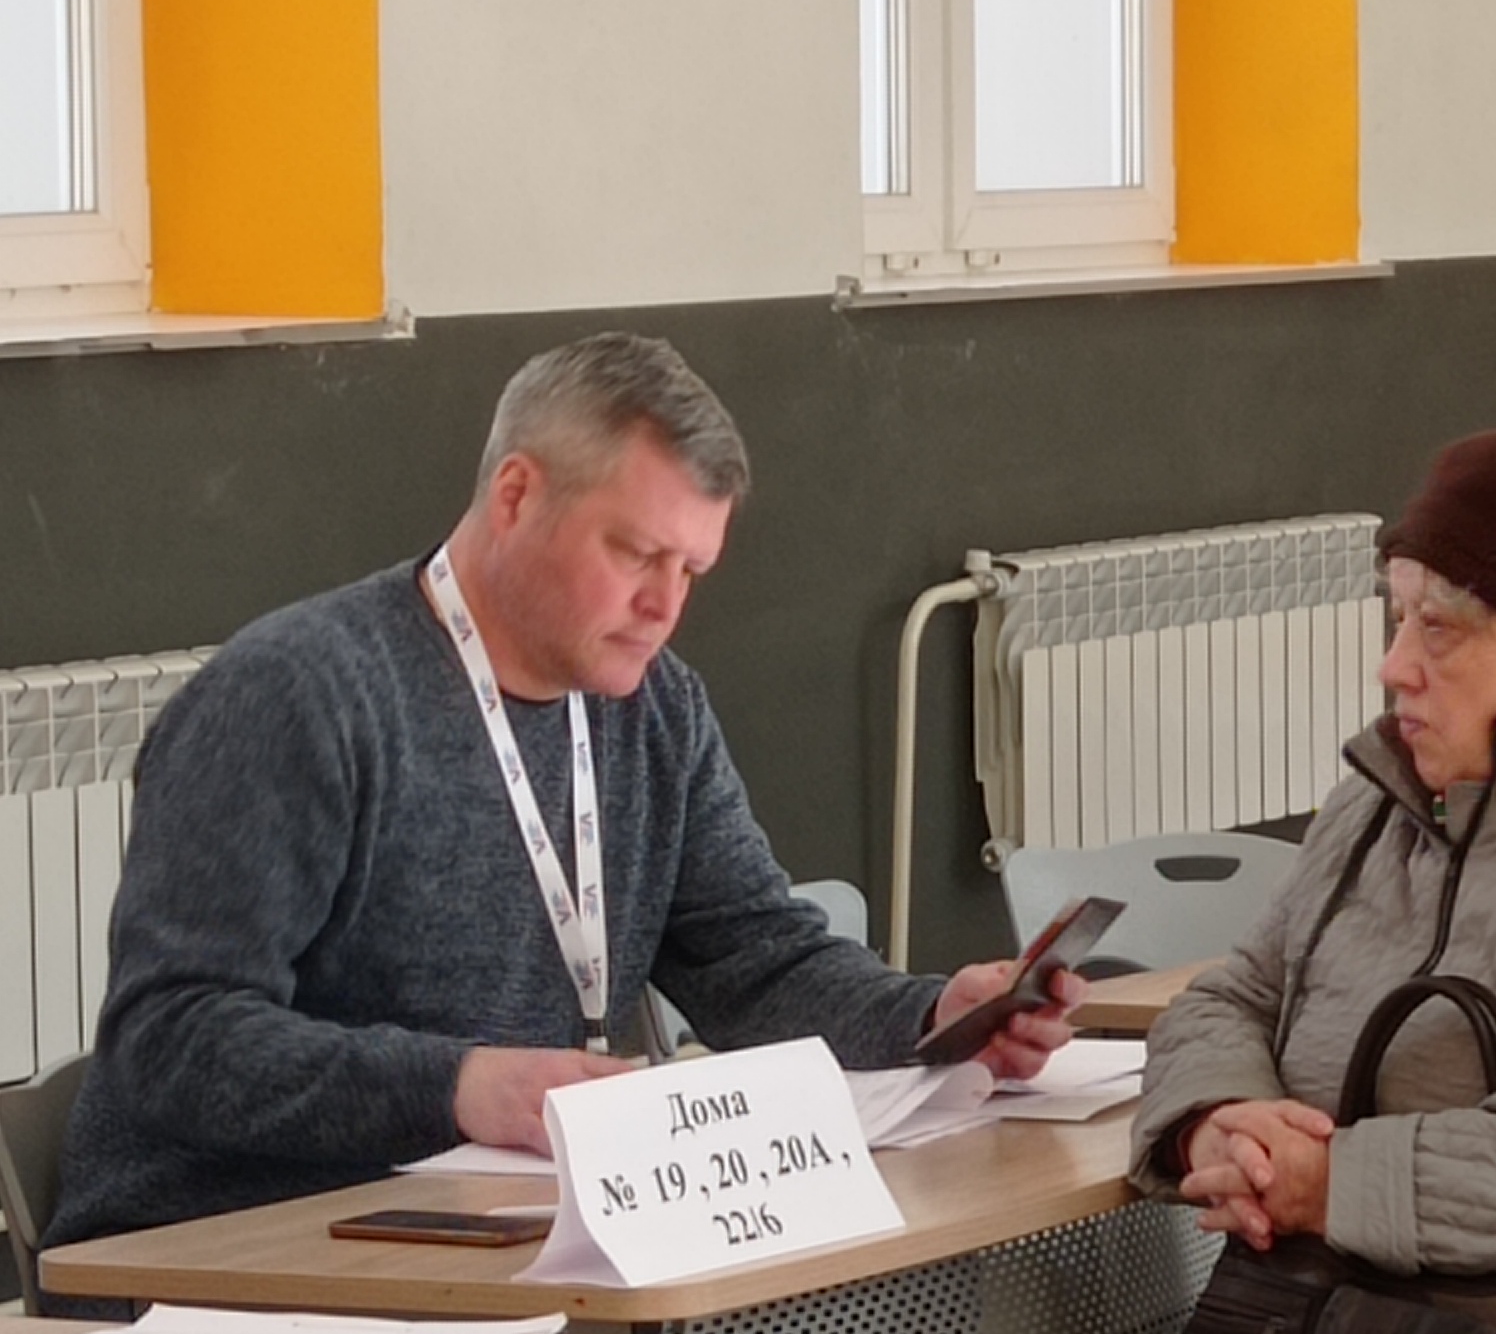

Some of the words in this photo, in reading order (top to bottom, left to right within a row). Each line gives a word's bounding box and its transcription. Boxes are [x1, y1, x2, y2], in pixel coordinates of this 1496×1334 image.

[667, 1089, 750, 1137] Дома
[600, 1175, 638, 1216] №
[712, 1202, 784, 1245] 22/6
